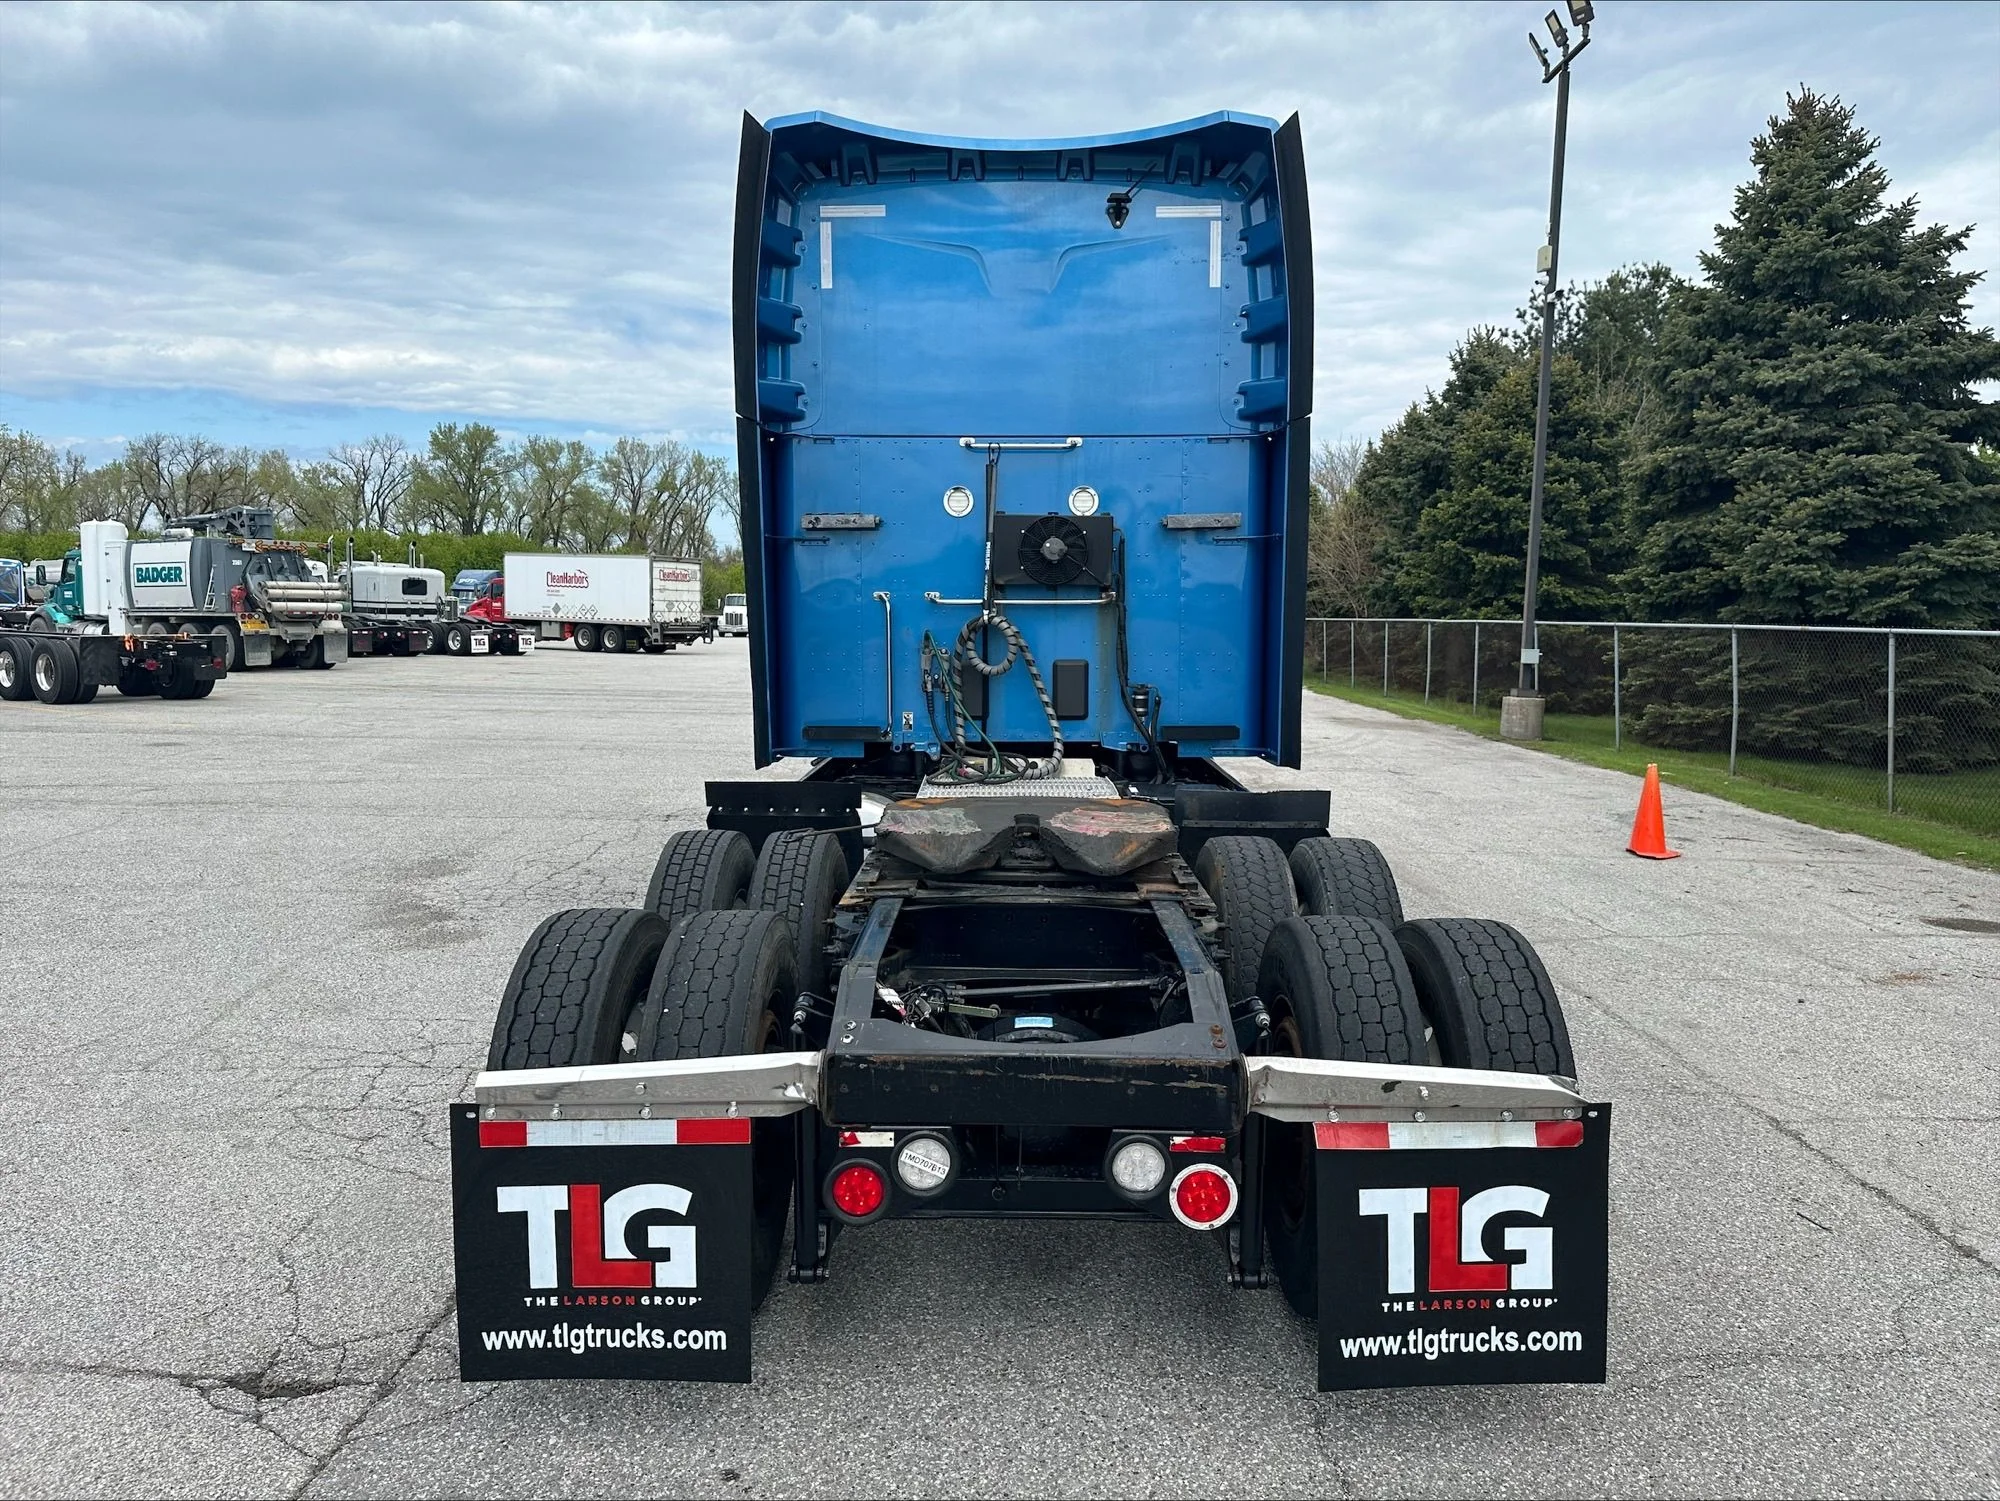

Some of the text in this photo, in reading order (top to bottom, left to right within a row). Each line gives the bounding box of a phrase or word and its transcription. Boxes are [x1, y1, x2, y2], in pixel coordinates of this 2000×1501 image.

[136, 566, 183, 583] BADGER
[474, 638, 486, 646] TLG
[521, 637, 532, 646] TLG
[497, 1183, 698, 1290] TLG
[1358, 1185, 1554, 1295] TLG
[523, 1295, 699, 1307] THE LARSON GROUP
[1381, 1297, 1555, 1313] THE LARSON GROUP
[481, 1321, 728, 1355] www.tlgtrucks.com
[1339, 1325, 1583, 1361] www.tlgtrucks.com
